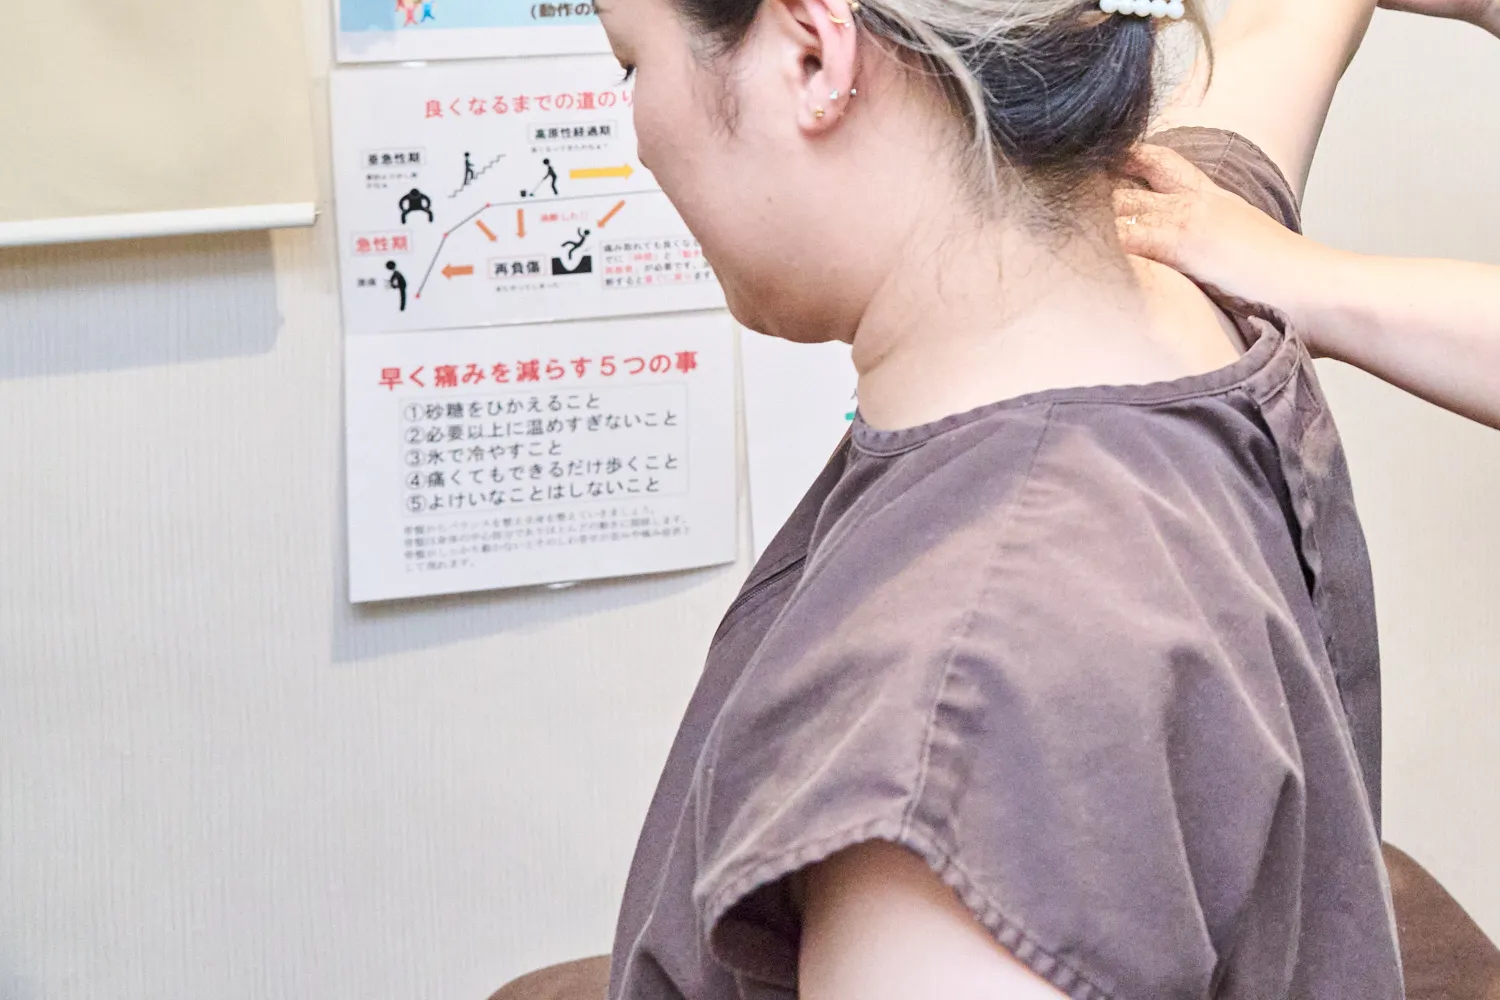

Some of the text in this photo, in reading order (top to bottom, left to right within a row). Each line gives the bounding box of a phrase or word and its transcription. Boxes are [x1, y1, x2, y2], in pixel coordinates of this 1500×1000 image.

[424, 89, 634, 119] 良くなるまでの道のり
[355, 235, 408, 252] 急性期
[494, 260, 541, 276] 再負傷
[378, 350, 698, 391] 早く痛みを減らす5つの事
[404, 394, 601, 422] ①砂糖をひかえること
[405, 410, 678, 445] ②必要以上に温めすぎないこと
[405, 440, 563, 467] ③氷で冷やすこと
[405, 453, 679, 490] ④痛くてもできるだけ歩くこと
[406, 477, 660, 512] ⑤よけいなことはしないこと
